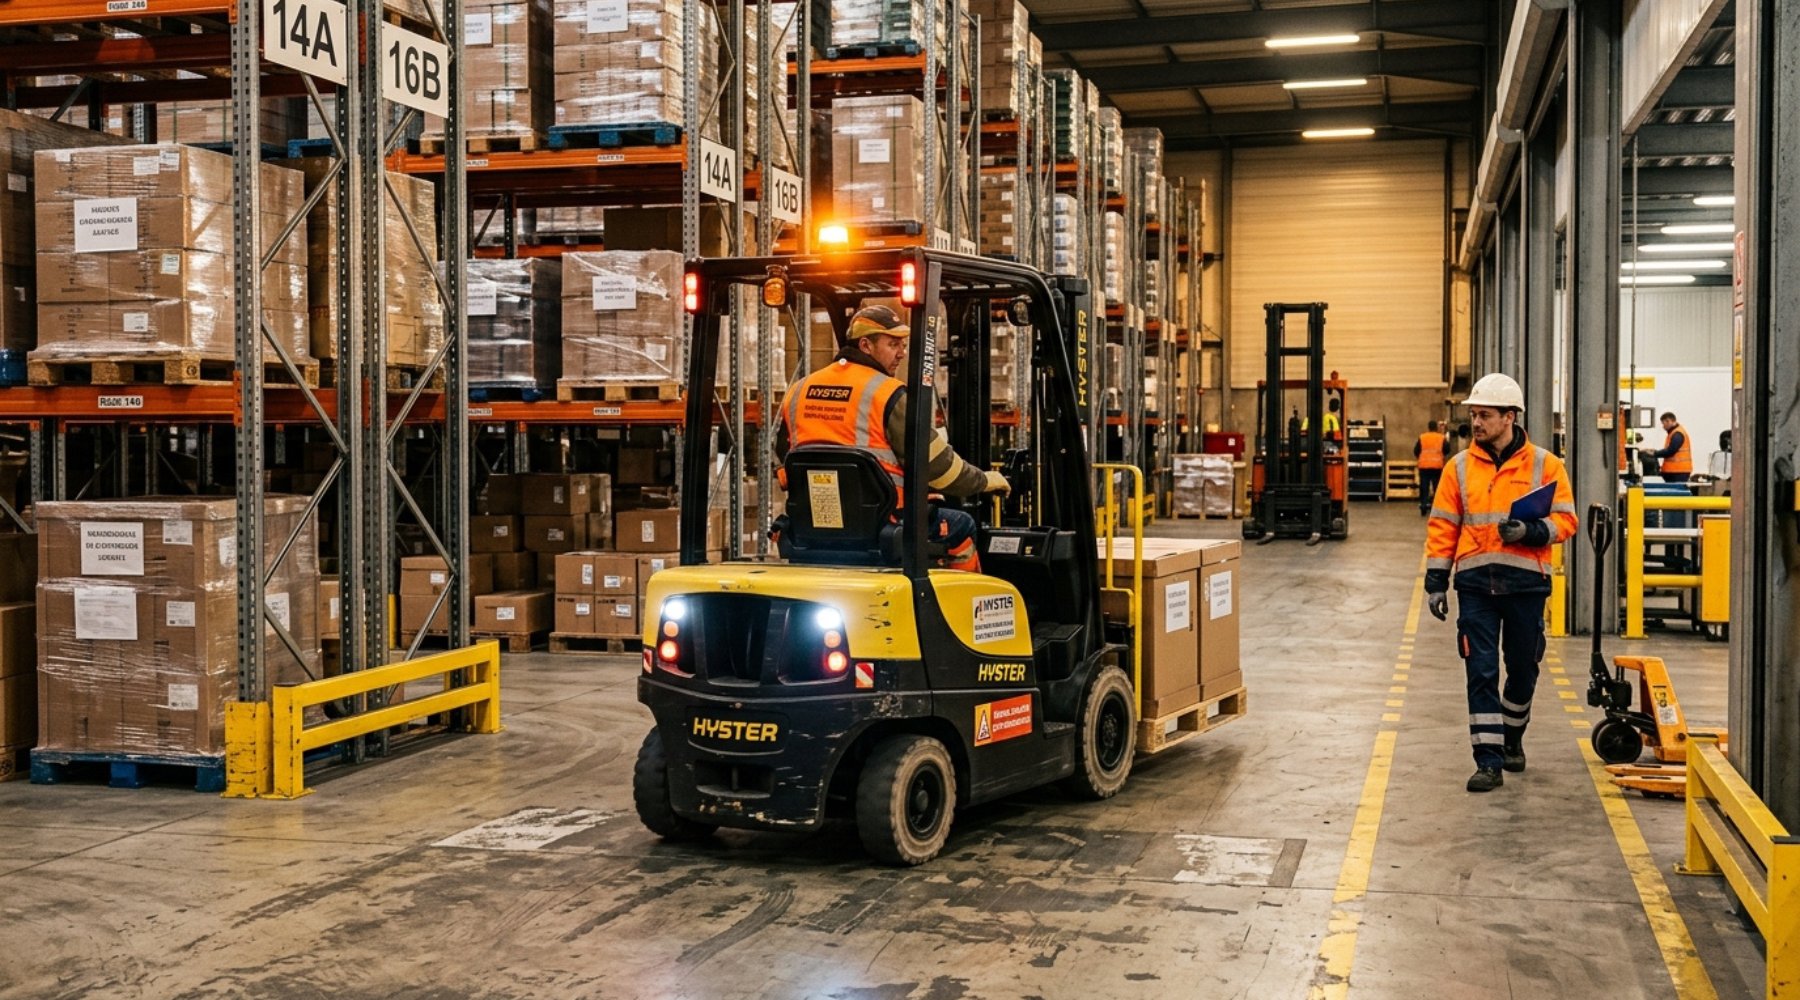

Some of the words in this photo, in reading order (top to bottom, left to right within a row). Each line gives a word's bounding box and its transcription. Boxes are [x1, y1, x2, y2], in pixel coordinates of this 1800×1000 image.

[273, 0, 337, 67] 14A
[389, 40, 441, 101] 16B
[705, 151, 732, 192] 14A
[775, 178, 798, 213] 16B
[978, 663, 1027, 682] HYSTER
[692, 716, 779, 742] HYSTER
